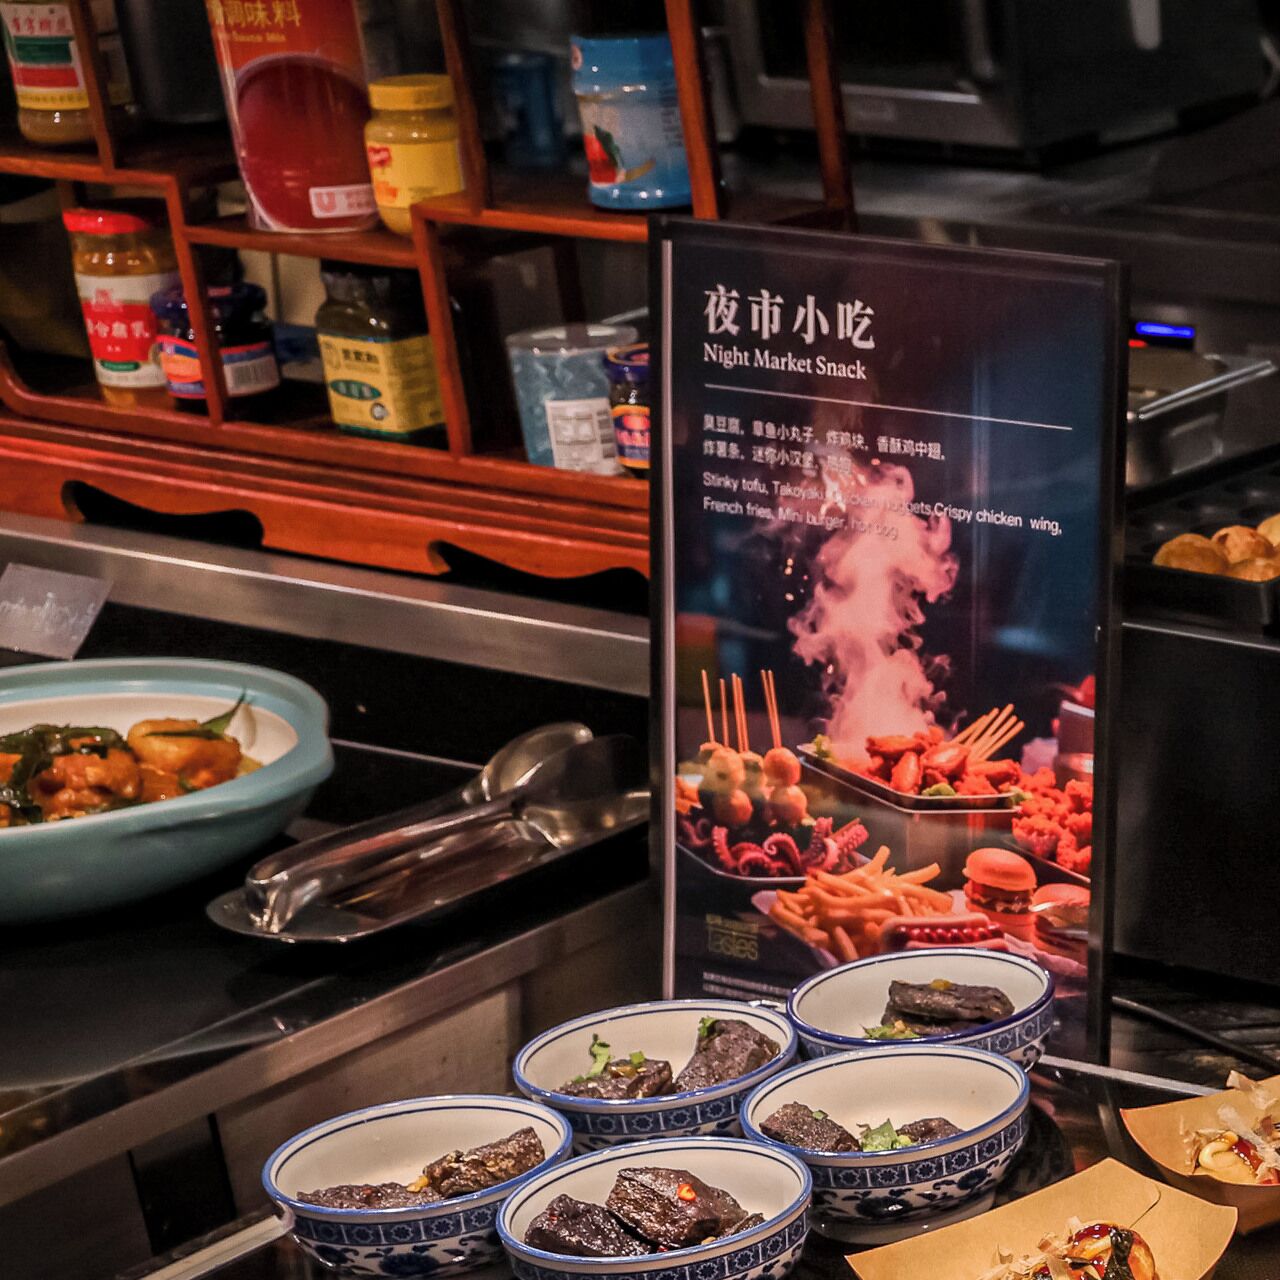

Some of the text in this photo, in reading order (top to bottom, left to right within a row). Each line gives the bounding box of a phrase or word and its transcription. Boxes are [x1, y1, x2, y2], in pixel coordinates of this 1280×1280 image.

[704, 284, 876, 349] 夜市小吃
[703, 342, 868, 380] Night Market Snack
[702, 472, 738, 492] Stinky
[742, 477, 769, 495] tofu,
[976, 509, 1023, 527] chicken
[702, 496, 743, 515] French
